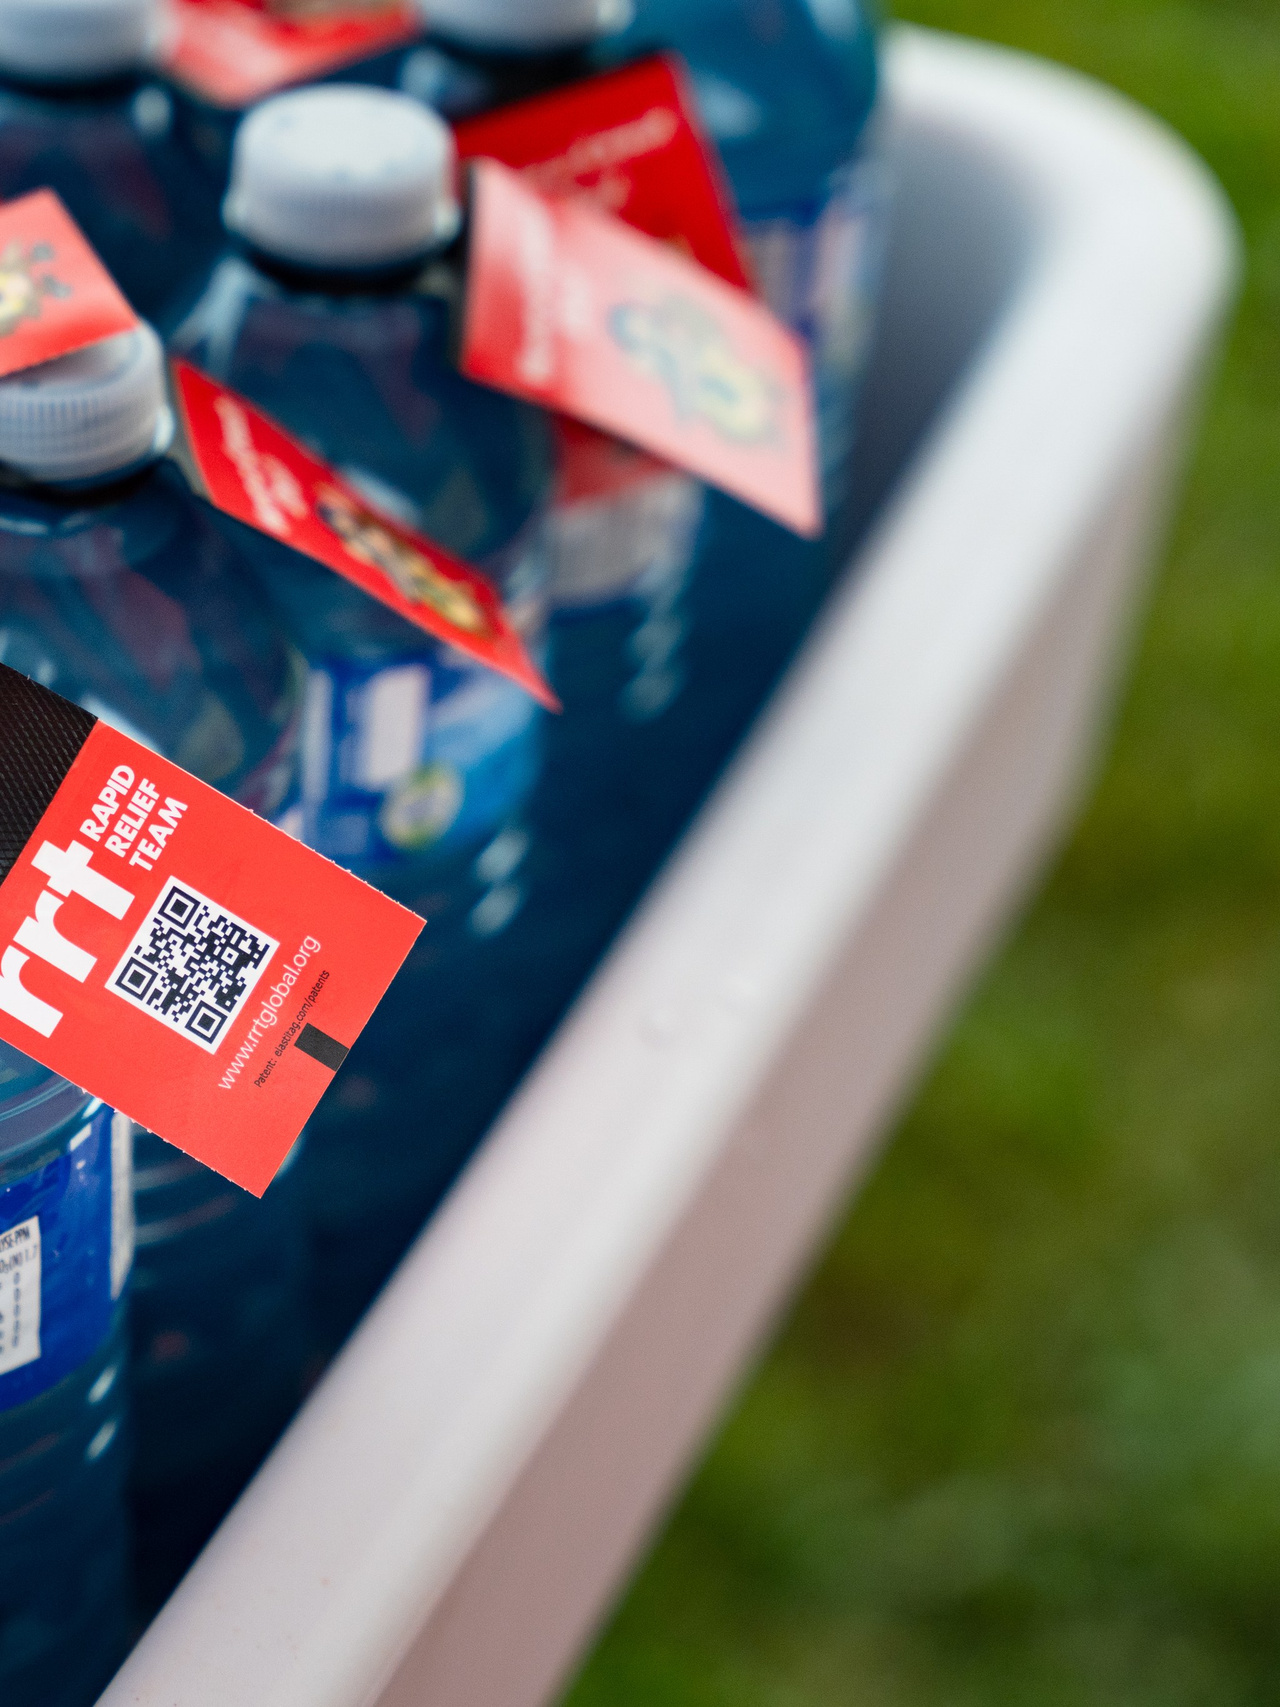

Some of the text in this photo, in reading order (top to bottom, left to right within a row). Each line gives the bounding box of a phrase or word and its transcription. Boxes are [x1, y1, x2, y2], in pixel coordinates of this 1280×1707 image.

[79, 764, 135, 842] RAPID
[104, 778, 163, 858] RELIEF
[129, 797, 189, 871] TEAM
[218, 935, 321, 1089] www.rrtglobal.org
[253, 969, 330, 1088] Patent: elastitag.com/patents
